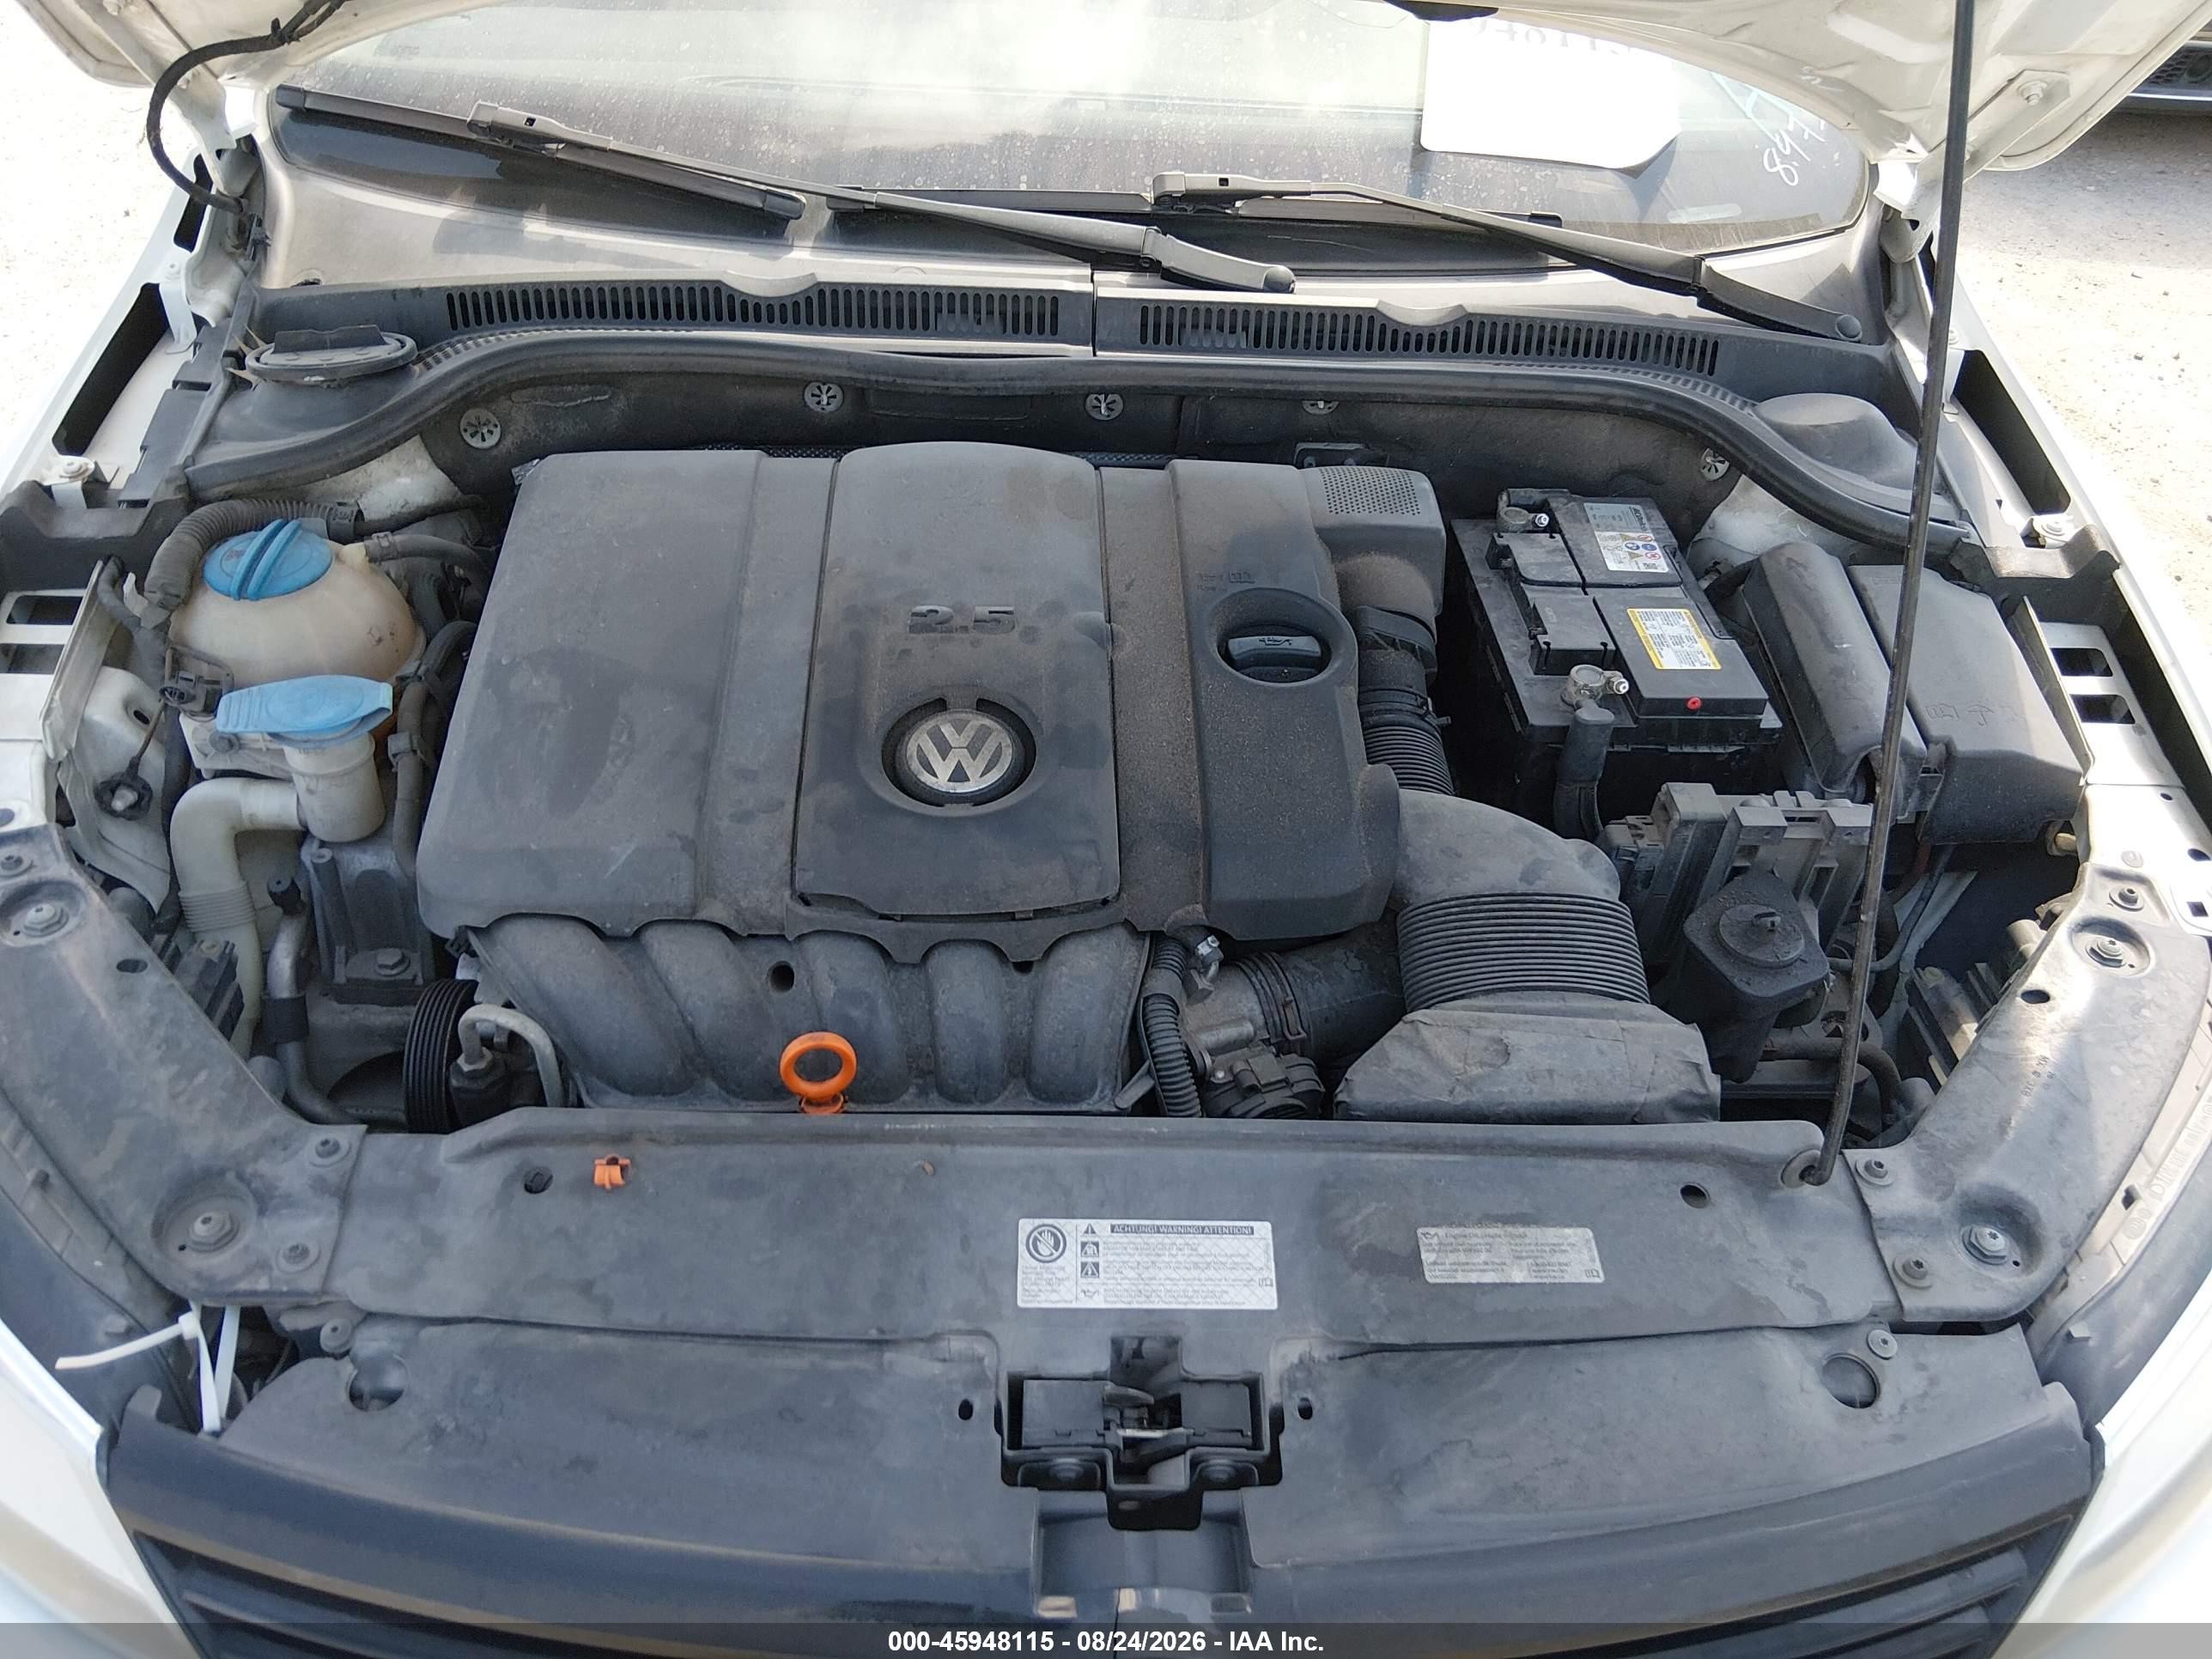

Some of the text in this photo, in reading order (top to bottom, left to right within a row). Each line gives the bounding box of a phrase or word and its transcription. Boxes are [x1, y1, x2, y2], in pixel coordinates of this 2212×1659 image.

[908, 605, 1016, 634] 2.5
[908, 711, 1012, 792] VW
[1114, 1224, 1252, 1235] ACHTUNG! WARNING! ATTENTION!
